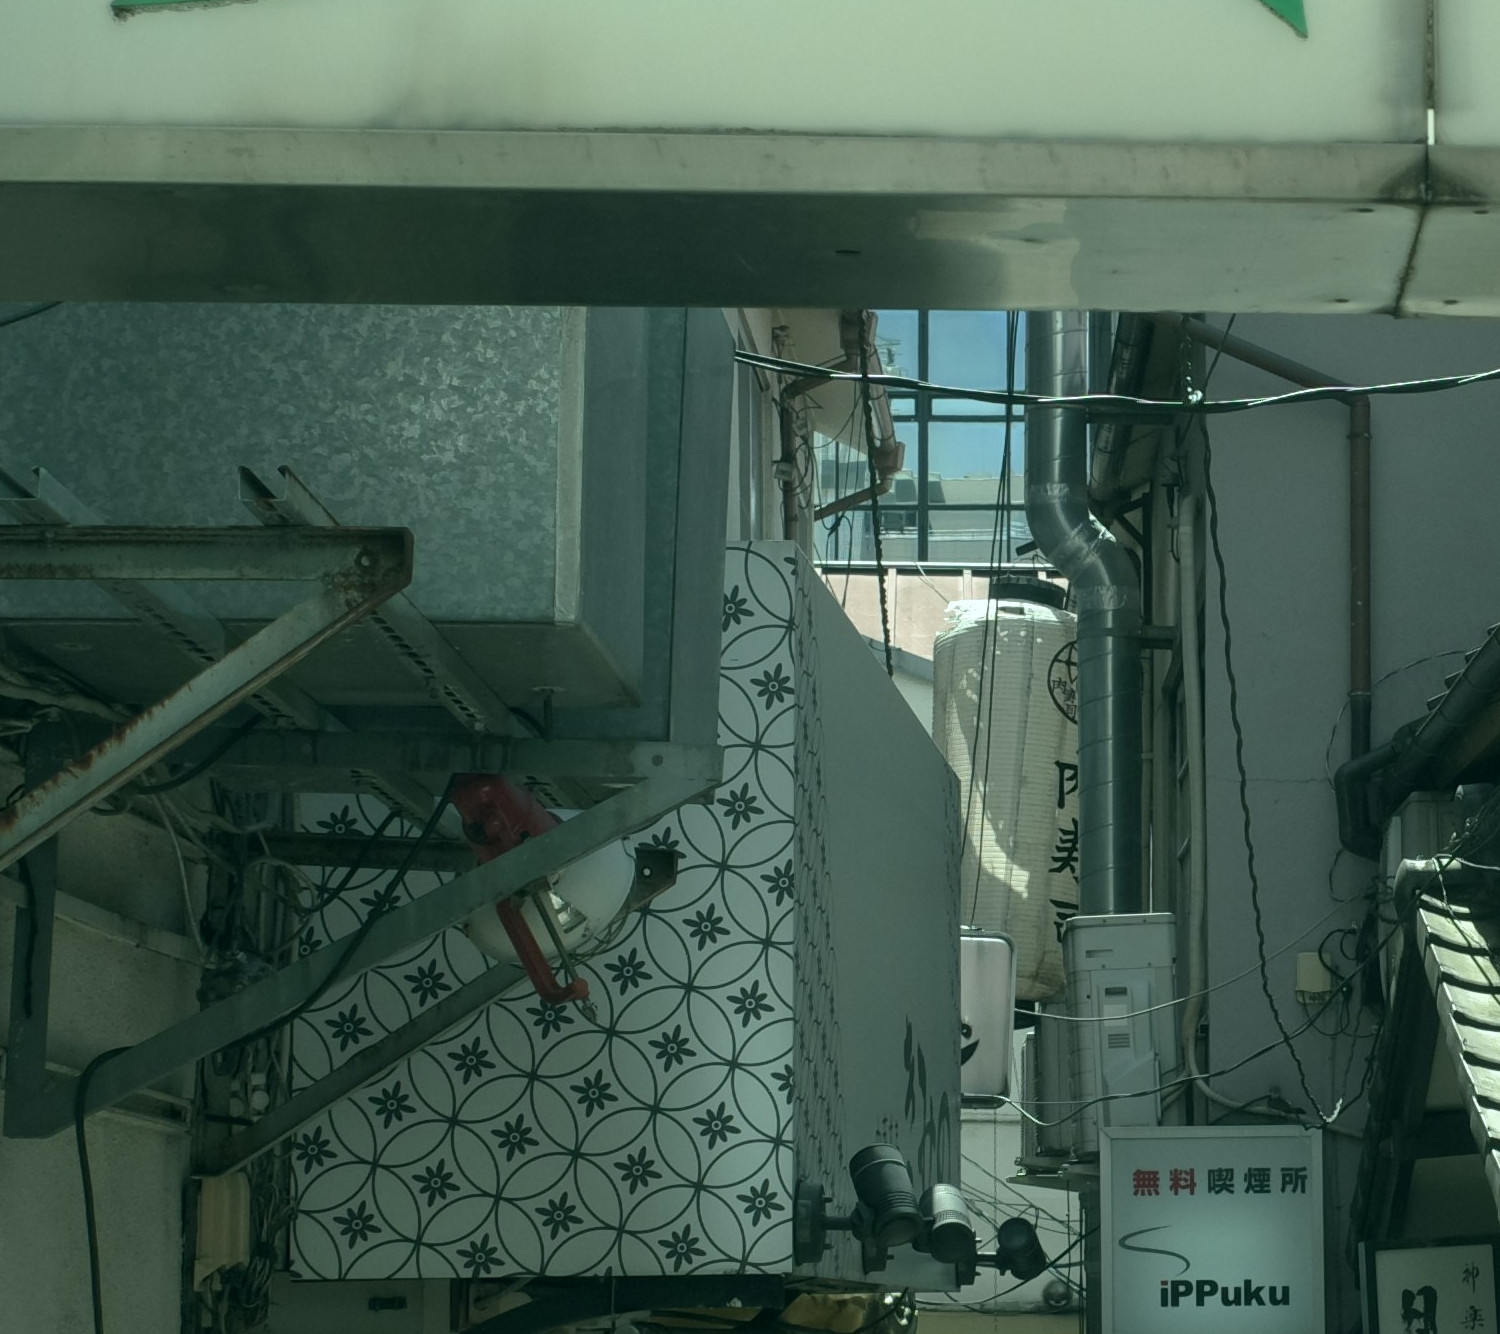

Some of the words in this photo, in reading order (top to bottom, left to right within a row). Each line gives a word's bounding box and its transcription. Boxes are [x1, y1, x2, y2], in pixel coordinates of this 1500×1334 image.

[1132, 1166, 1309, 1197] 無料喫煙所
[1160, 1279, 1290, 1308] iPPuku
